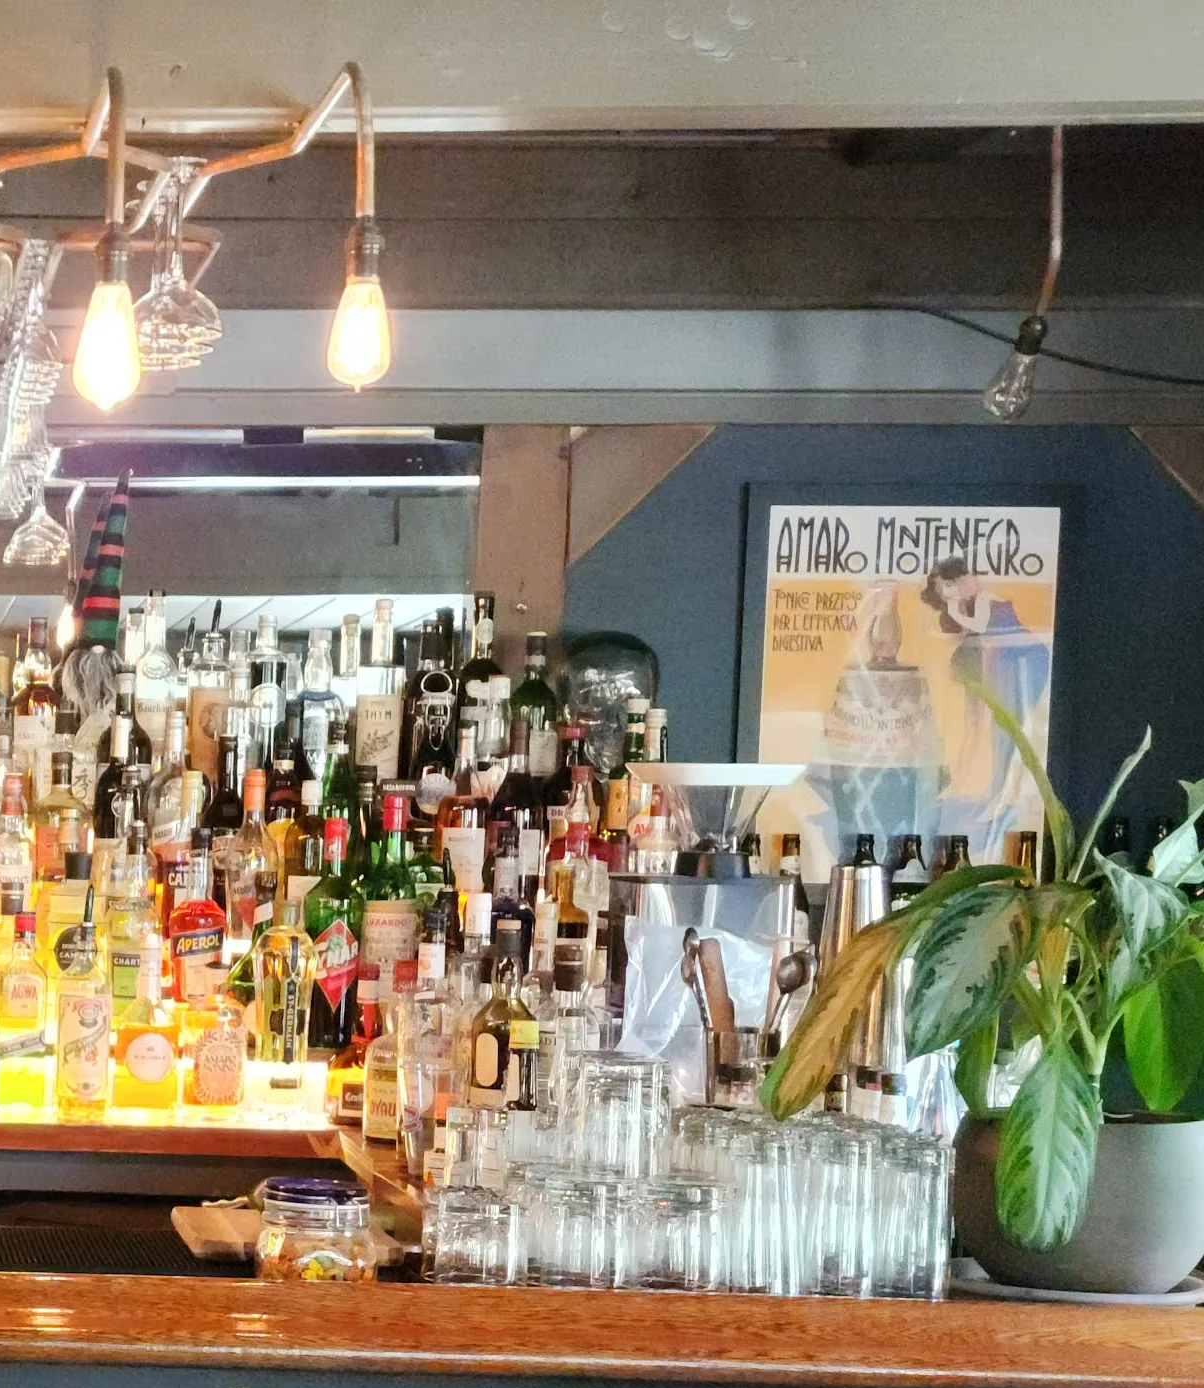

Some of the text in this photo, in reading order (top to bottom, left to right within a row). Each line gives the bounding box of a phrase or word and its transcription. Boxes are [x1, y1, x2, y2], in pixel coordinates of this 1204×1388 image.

[776, 516, 868, 574] AMARO
[773, 614, 790, 631] PER
[772, 635, 824, 651] DIGESTIVA
[365, 709, 393, 720] THYM
[177, 933, 220, 955] APEROL
[11, 984, 38, 1000] AGWA
